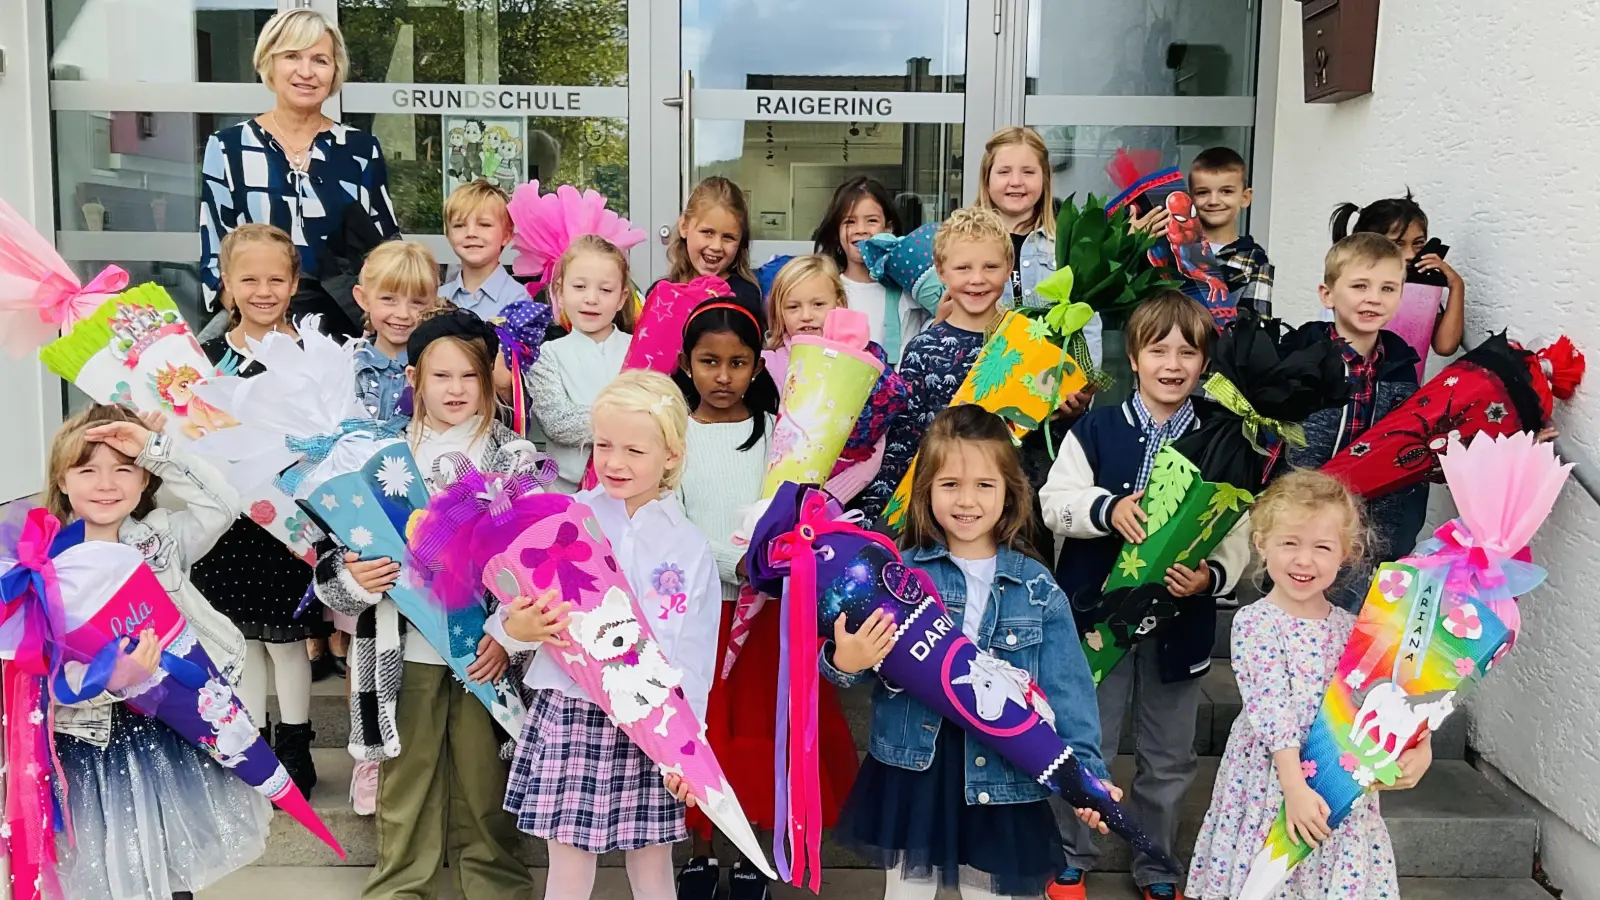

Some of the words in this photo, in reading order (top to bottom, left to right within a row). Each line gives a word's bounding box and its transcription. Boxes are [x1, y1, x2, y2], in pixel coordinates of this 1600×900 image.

[393, 89, 581, 111] GRUNDSCHULE
[756, 96, 893, 116] RAIGERING
[909, 613, 955, 662] DARI
[1404, 585, 1432, 662] ARIANA
